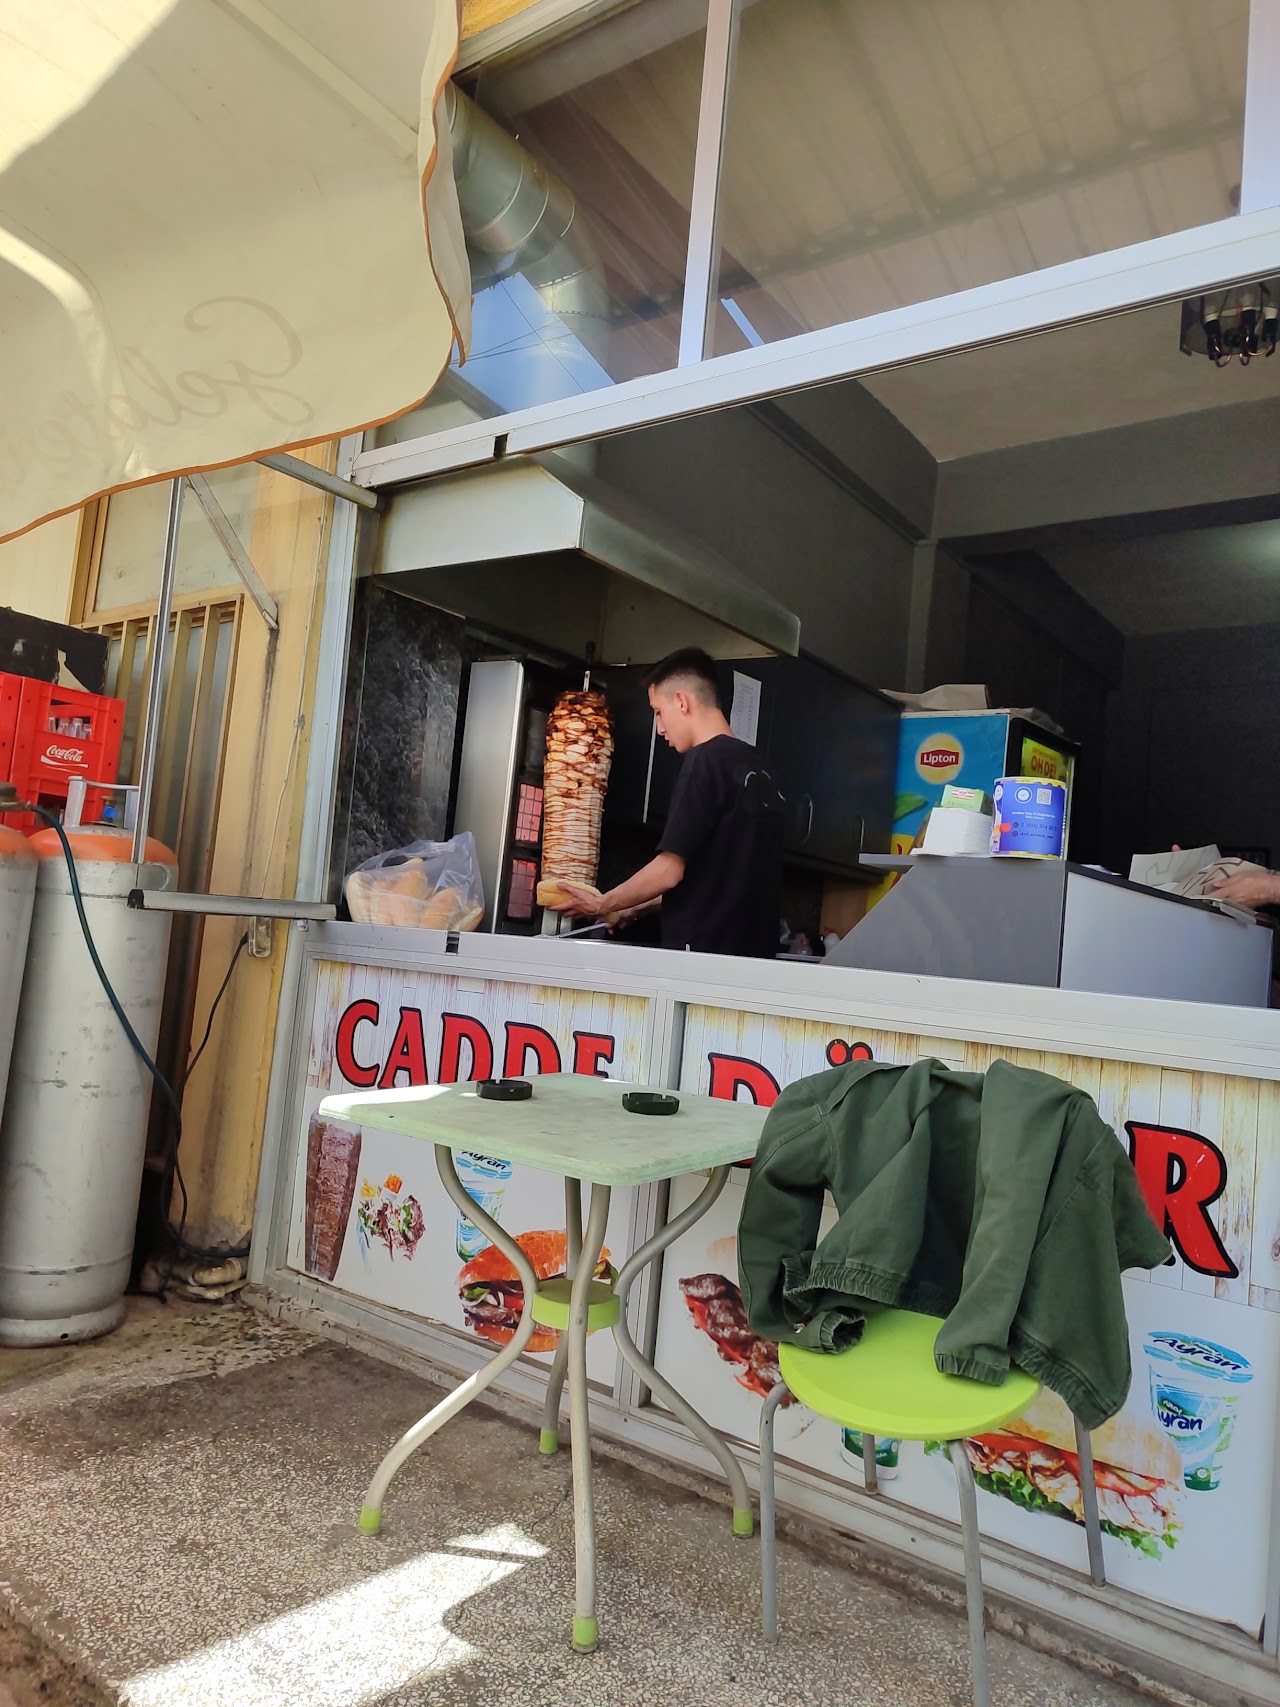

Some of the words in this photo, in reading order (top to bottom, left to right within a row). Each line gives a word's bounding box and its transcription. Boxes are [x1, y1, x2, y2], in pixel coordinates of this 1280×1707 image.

[46, 745, 84, 763] CocaCola
[923, 753, 956, 765] Lipton
[461, 1150, 507, 1170] Ayran
[1153, 1339, 1242, 1371] Ayran
